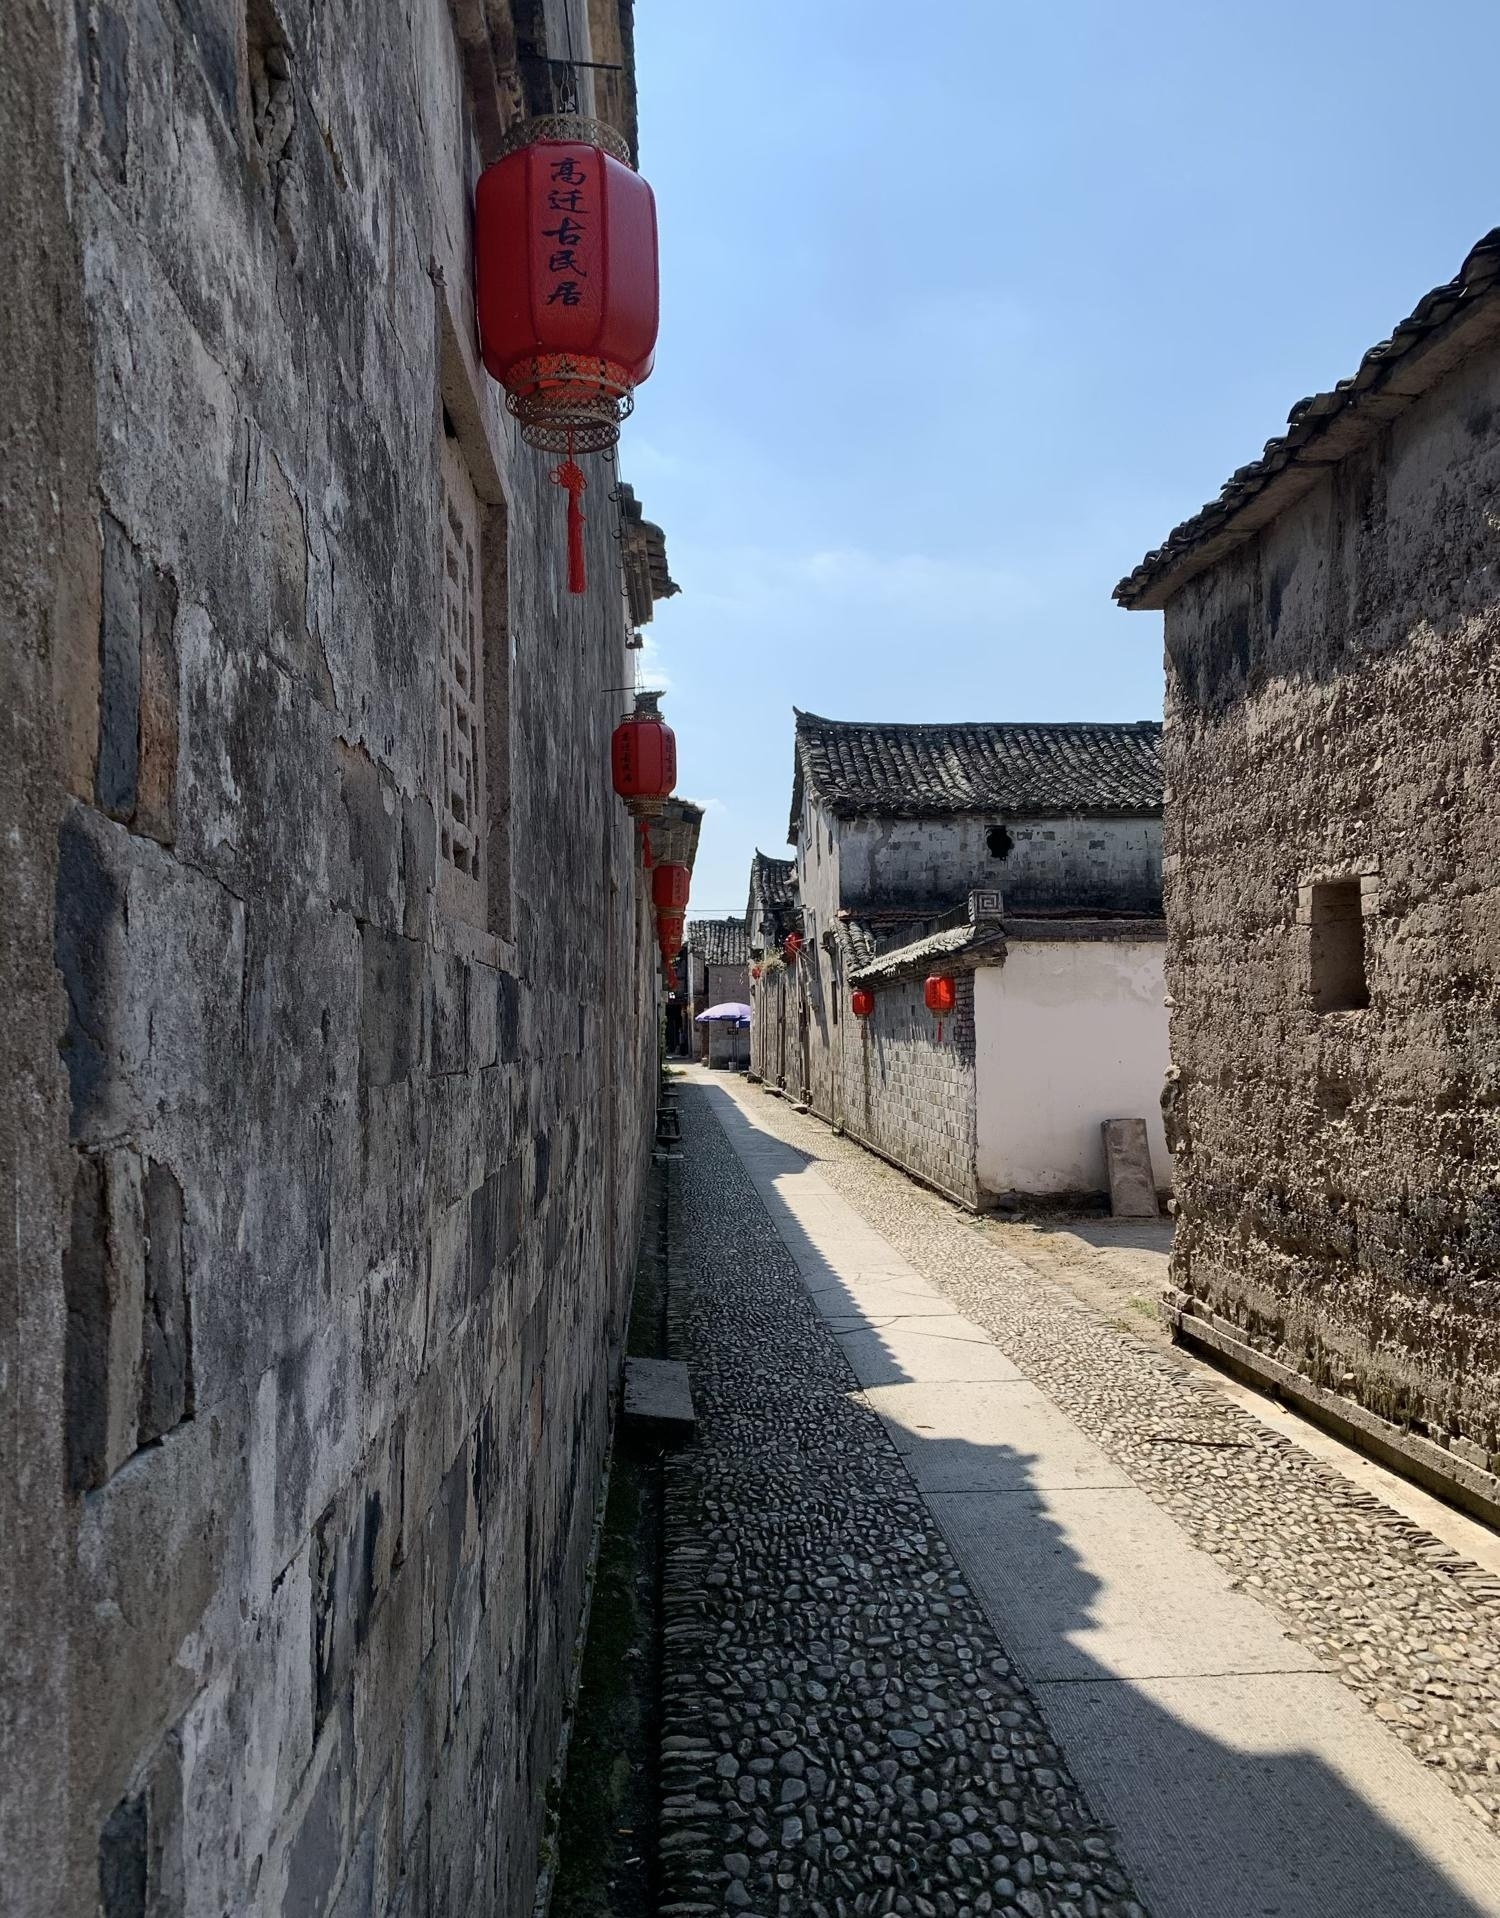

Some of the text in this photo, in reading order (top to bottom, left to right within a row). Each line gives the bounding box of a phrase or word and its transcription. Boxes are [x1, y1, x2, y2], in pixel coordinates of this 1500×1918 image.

[542, 157, 590, 306] 高迁古民居
